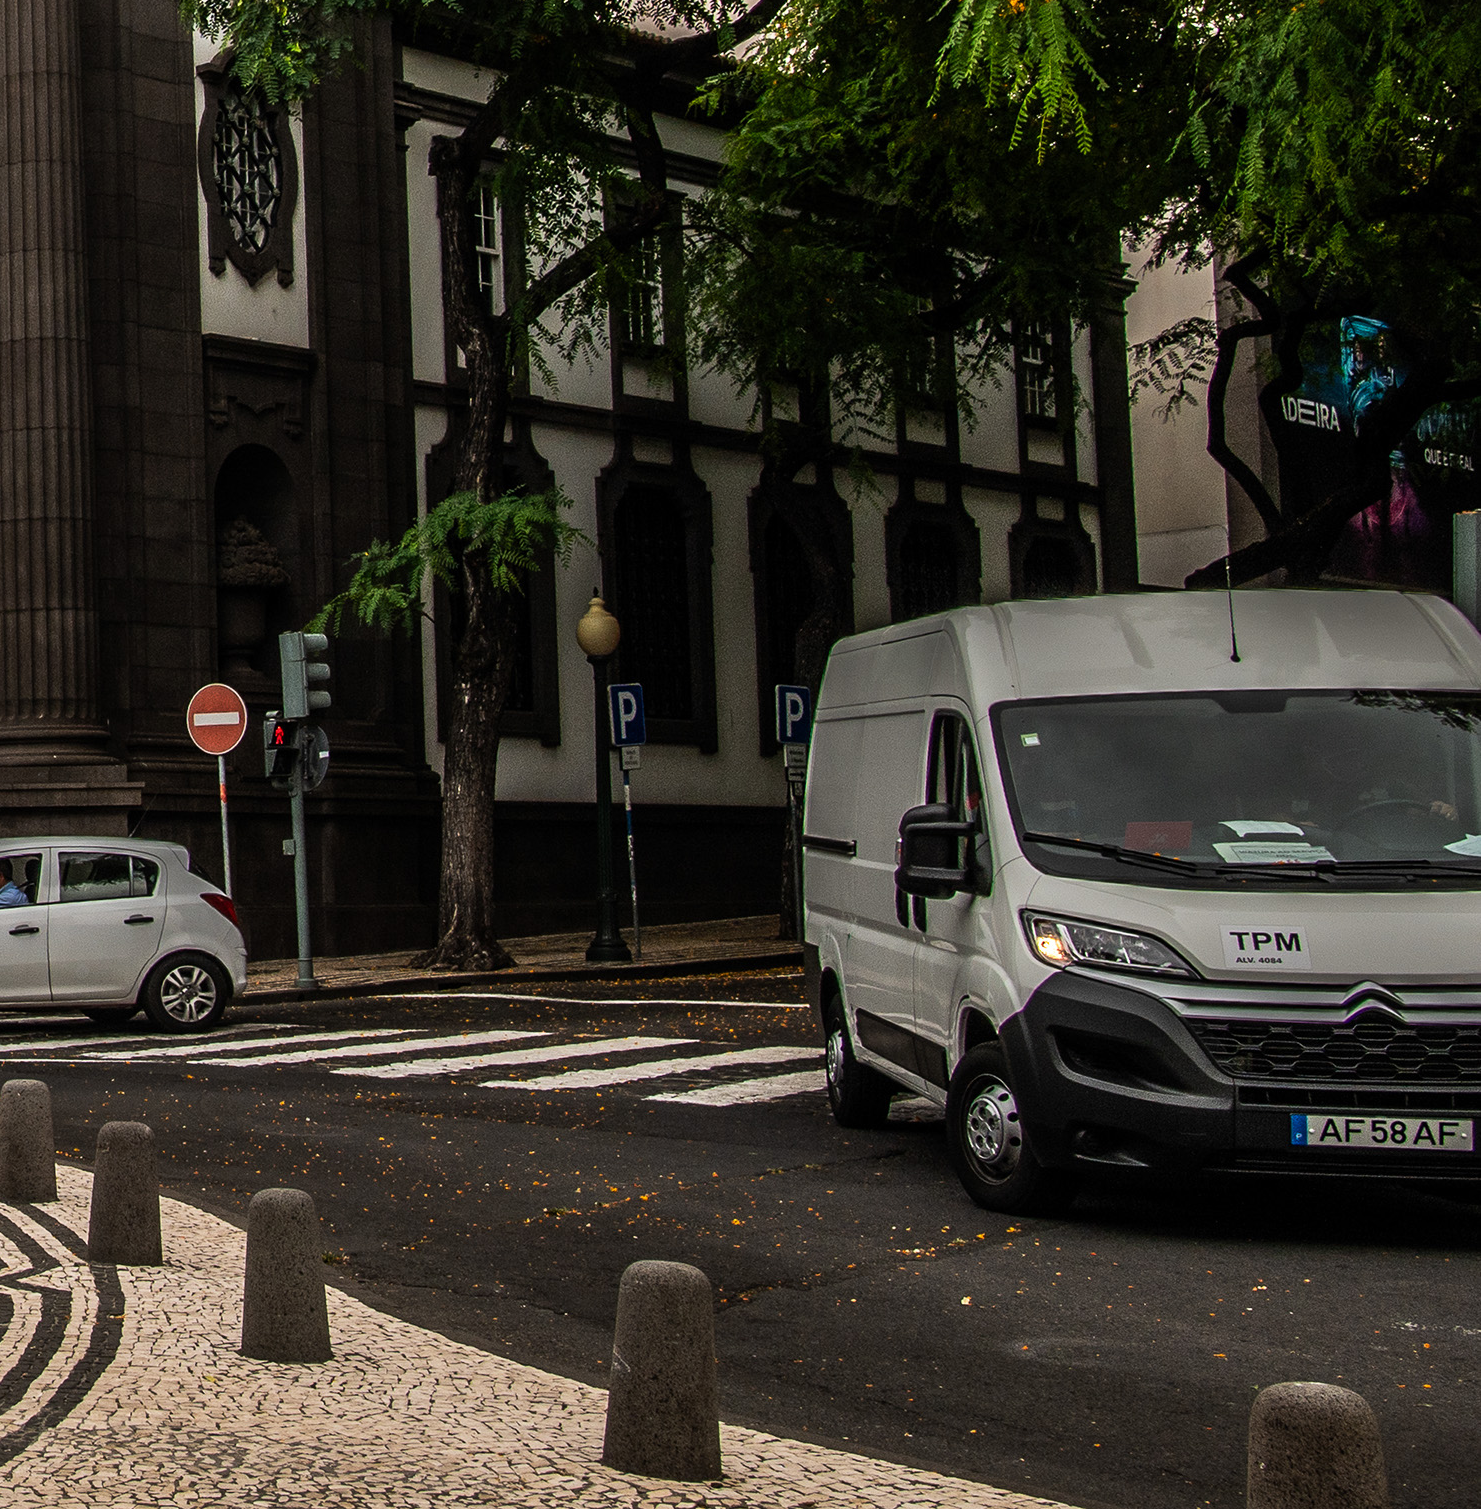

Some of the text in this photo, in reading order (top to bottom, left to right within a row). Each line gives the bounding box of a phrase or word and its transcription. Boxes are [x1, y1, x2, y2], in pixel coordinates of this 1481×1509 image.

[618, 691, 637, 739] P
[785, 692, 804, 738] P
[1229, 931, 1302, 952] TPM
[1258, 956, 1283, 964] 4084
